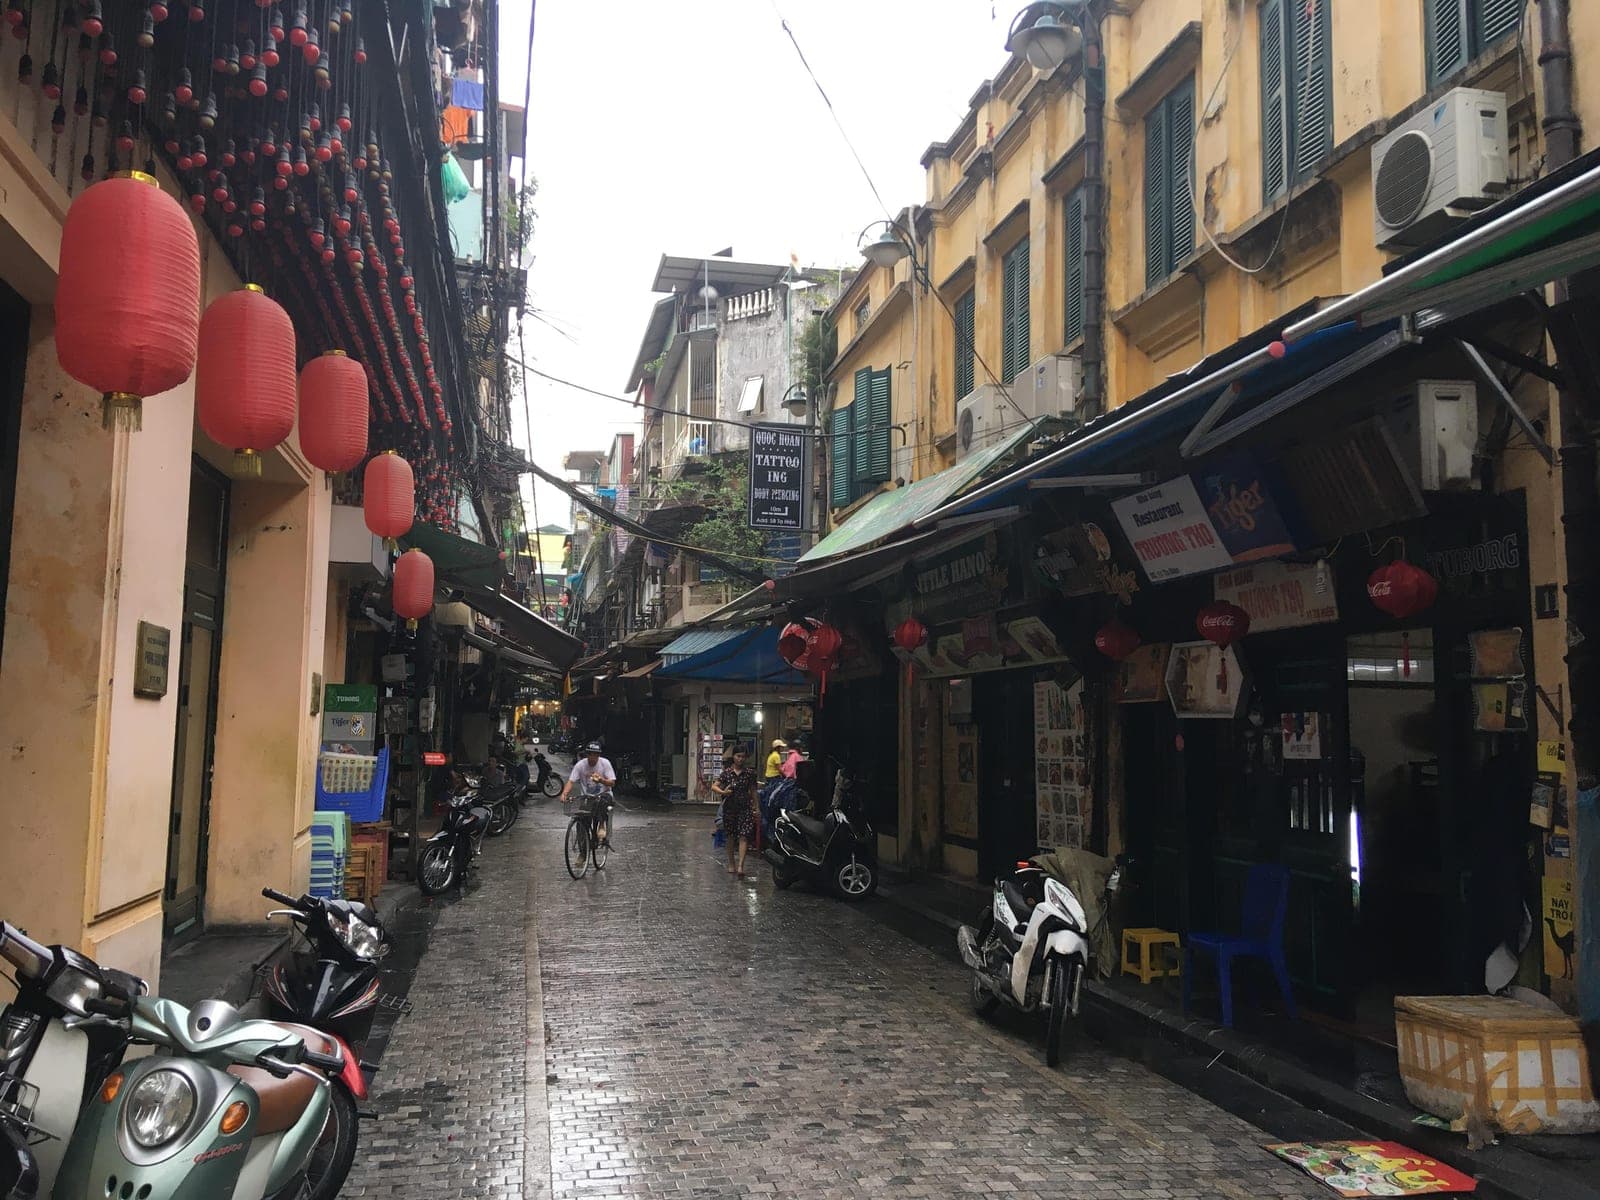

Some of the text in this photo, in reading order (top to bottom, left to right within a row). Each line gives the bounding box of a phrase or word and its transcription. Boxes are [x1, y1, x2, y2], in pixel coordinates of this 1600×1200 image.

[755, 454, 800, 468] TATTOO
[767, 470, 787, 483] ING
[754, 487, 799, 501] BODY PIERCING
[1132, 501, 1184, 528] Restaurant
[1425, 533, 1520, 577] TUBORG
[331, 717, 350, 727] Tiger
